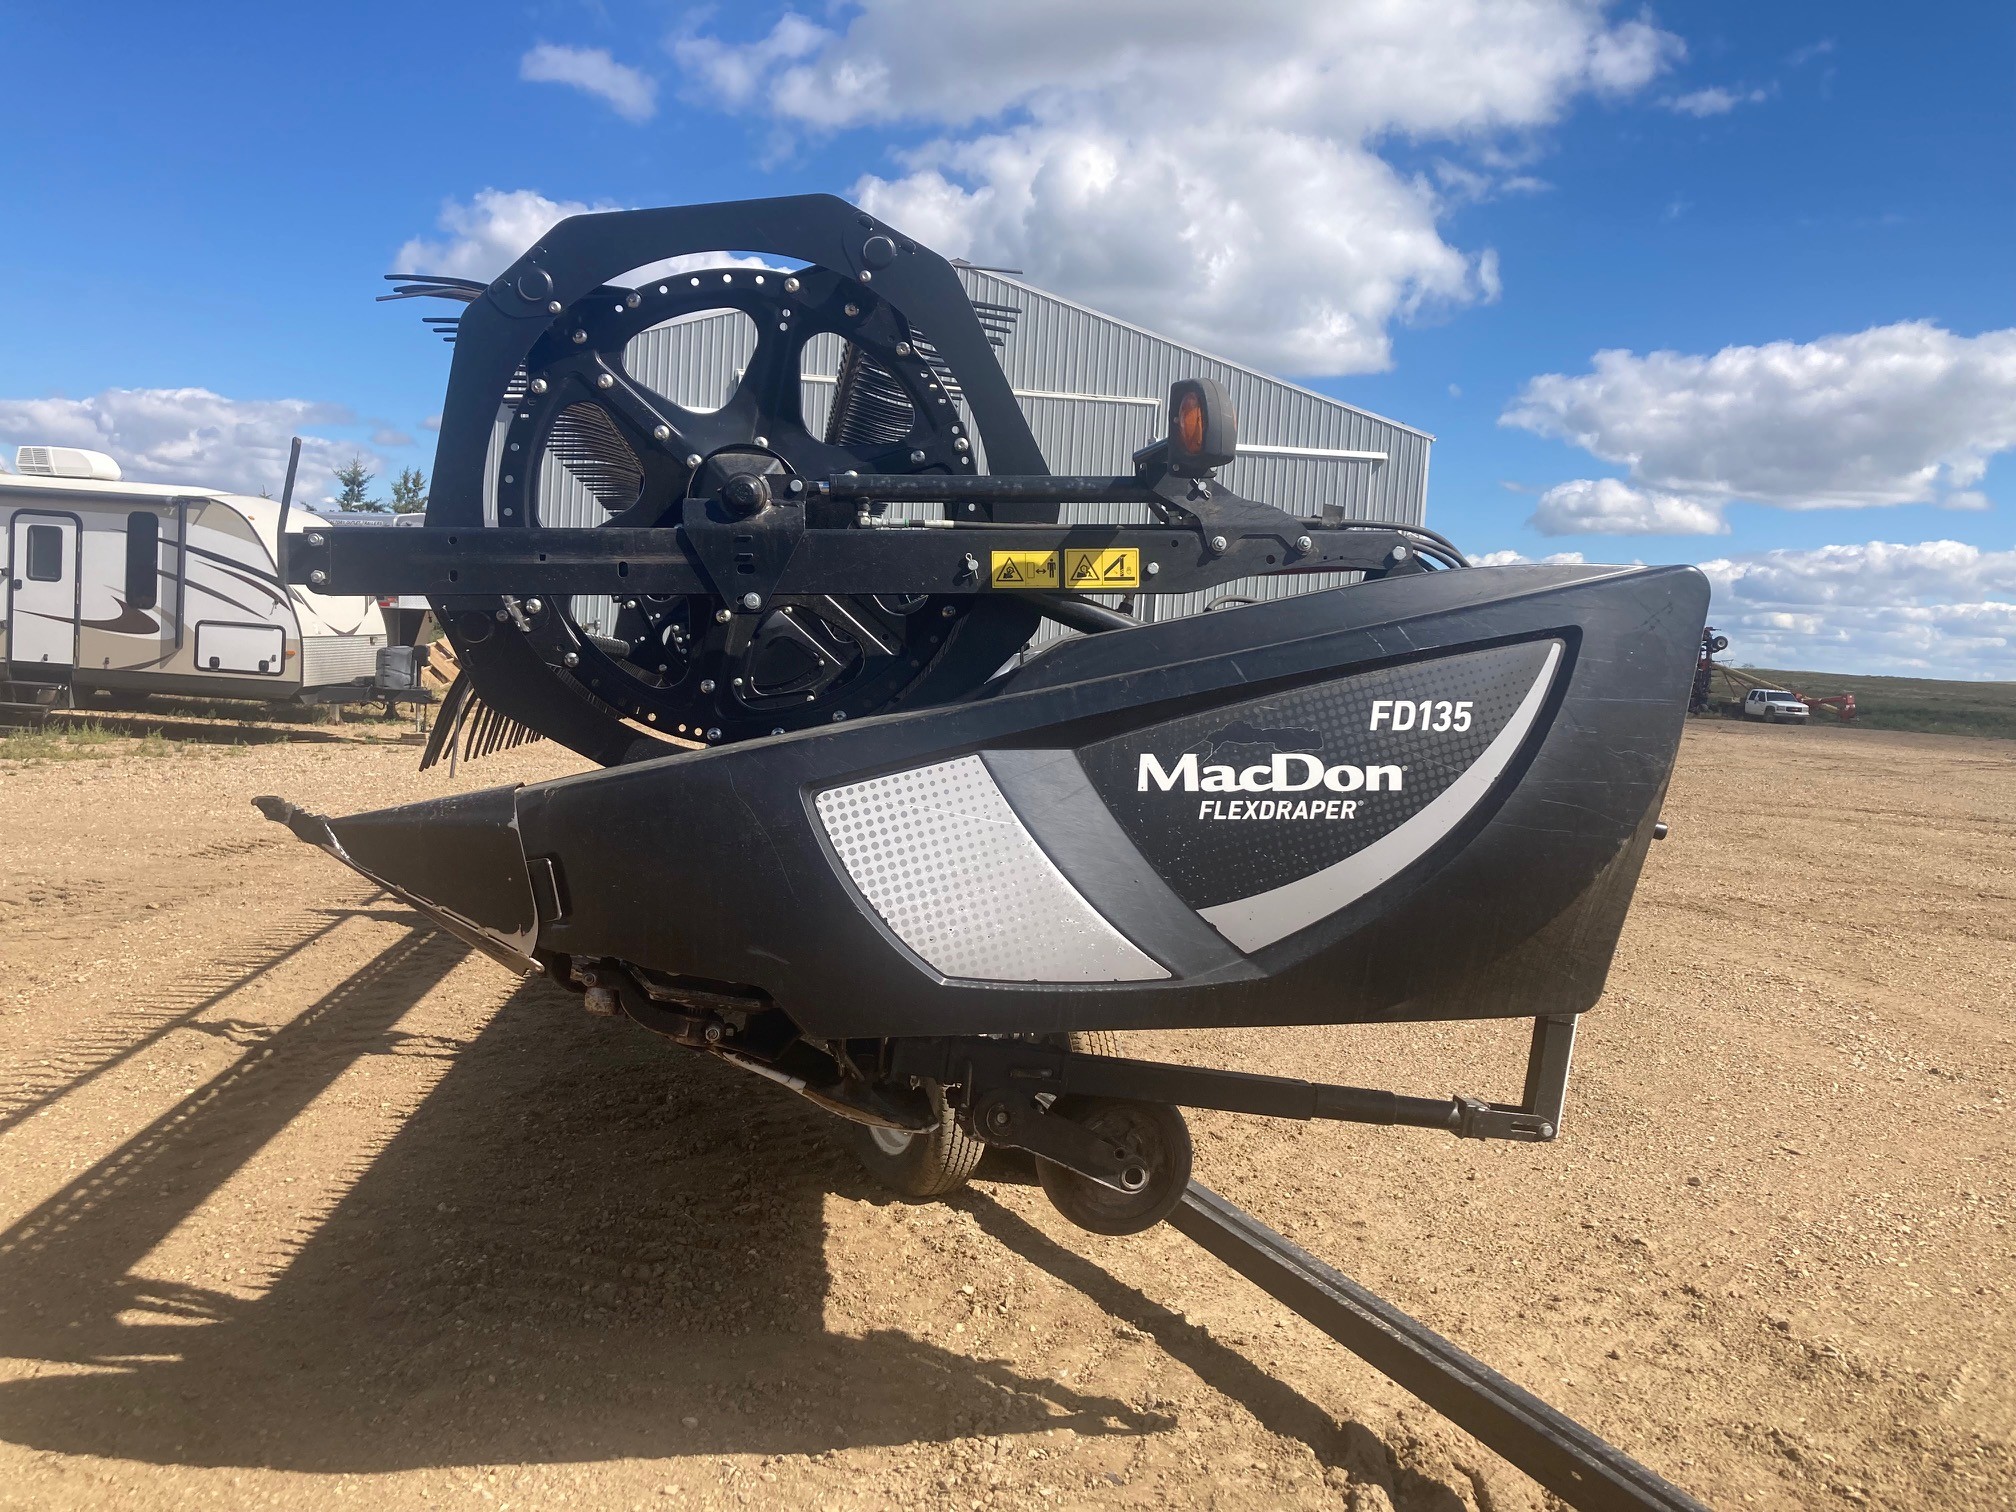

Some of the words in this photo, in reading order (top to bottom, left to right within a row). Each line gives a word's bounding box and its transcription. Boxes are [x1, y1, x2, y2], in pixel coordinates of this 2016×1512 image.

[1369, 700, 1474, 733] FD135
[1137, 753, 1403, 793] MacDon
[1198, 800, 1356, 820] FLEXDRAPER
